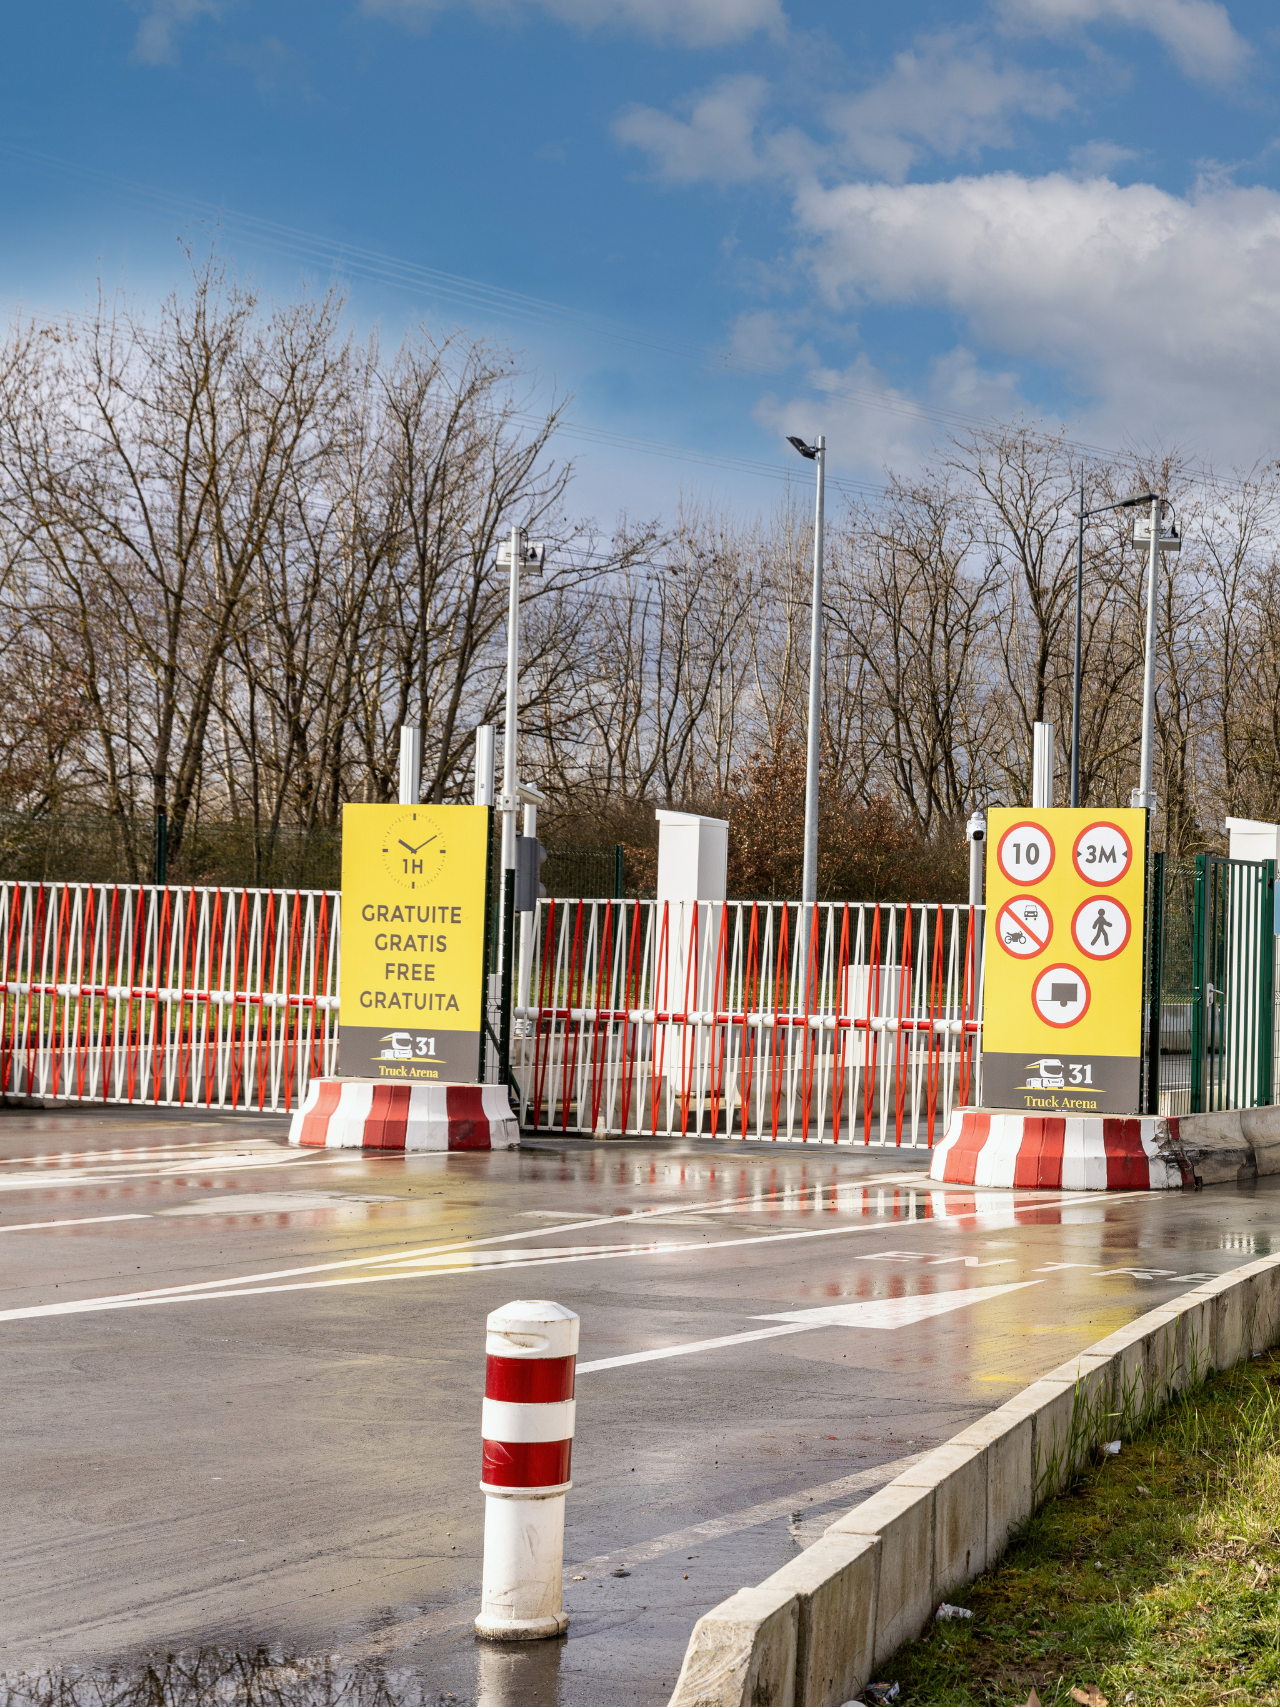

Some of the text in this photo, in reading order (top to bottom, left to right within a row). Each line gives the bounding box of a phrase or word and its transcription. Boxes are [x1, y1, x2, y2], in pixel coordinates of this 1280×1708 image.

[1012, 842, 1117, 865] 10 3M
[402, 858, 424, 875] 1H
[361, 904, 462, 924] GRATUITE
[374, 933, 447, 952] GRATIS
[385, 962, 435, 981] FREE
[359, 991, 460, 1012] GRATUITA
[415, 1036, 436, 1055] 31
[378, 1065, 439, 1079] Truck Arena
[1069, 1064, 1093, 1084] 31
[1024, 1096, 1097, 1109] Truck Arena
